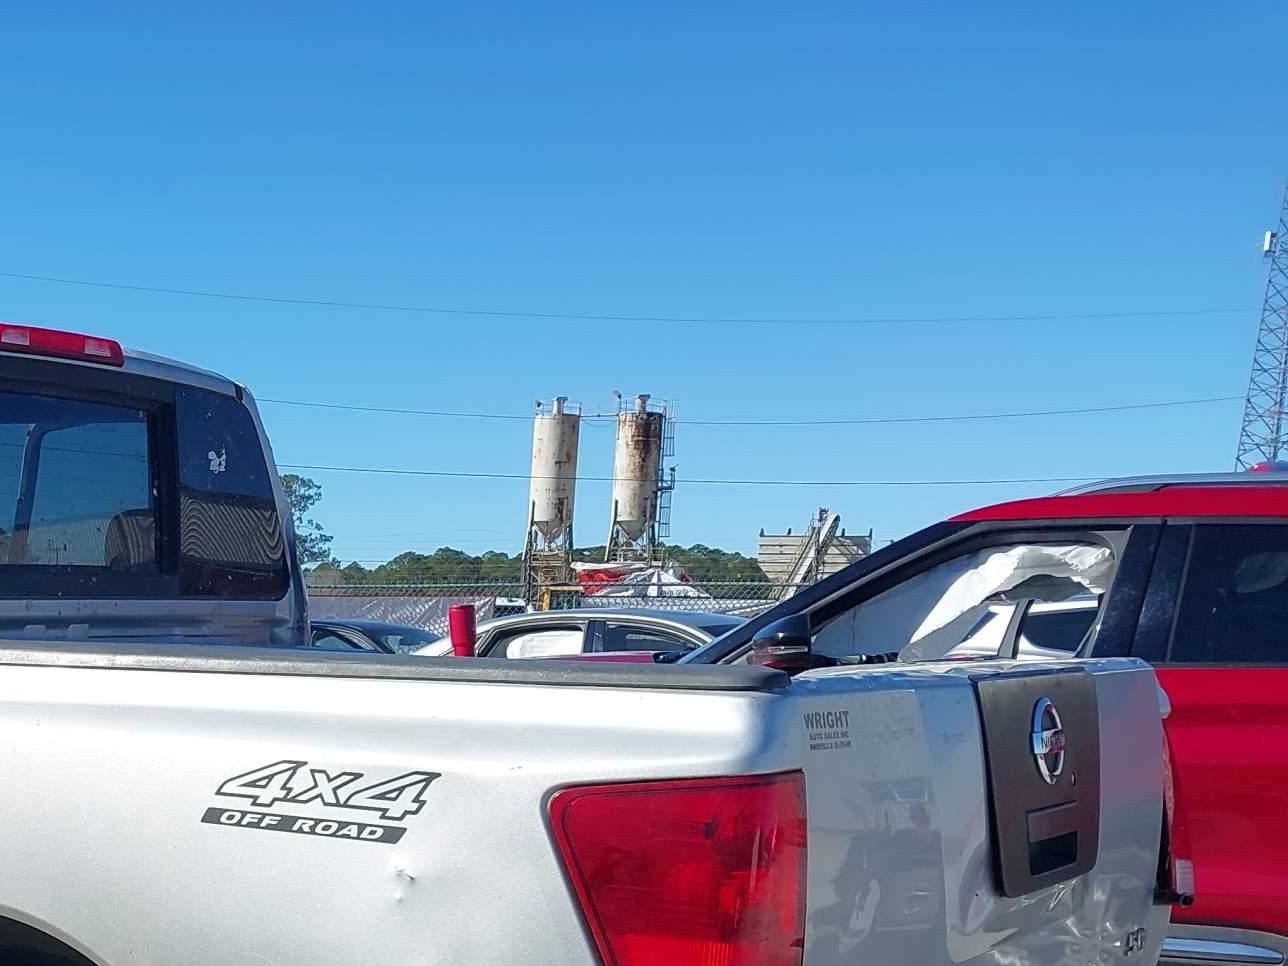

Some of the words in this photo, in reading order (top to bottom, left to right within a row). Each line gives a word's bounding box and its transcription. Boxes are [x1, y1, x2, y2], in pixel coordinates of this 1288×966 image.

[803, 710, 849, 730] WRIGHT
[219, 810, 282, 828] OFF
[291, 817, 385, 840] ROAD
